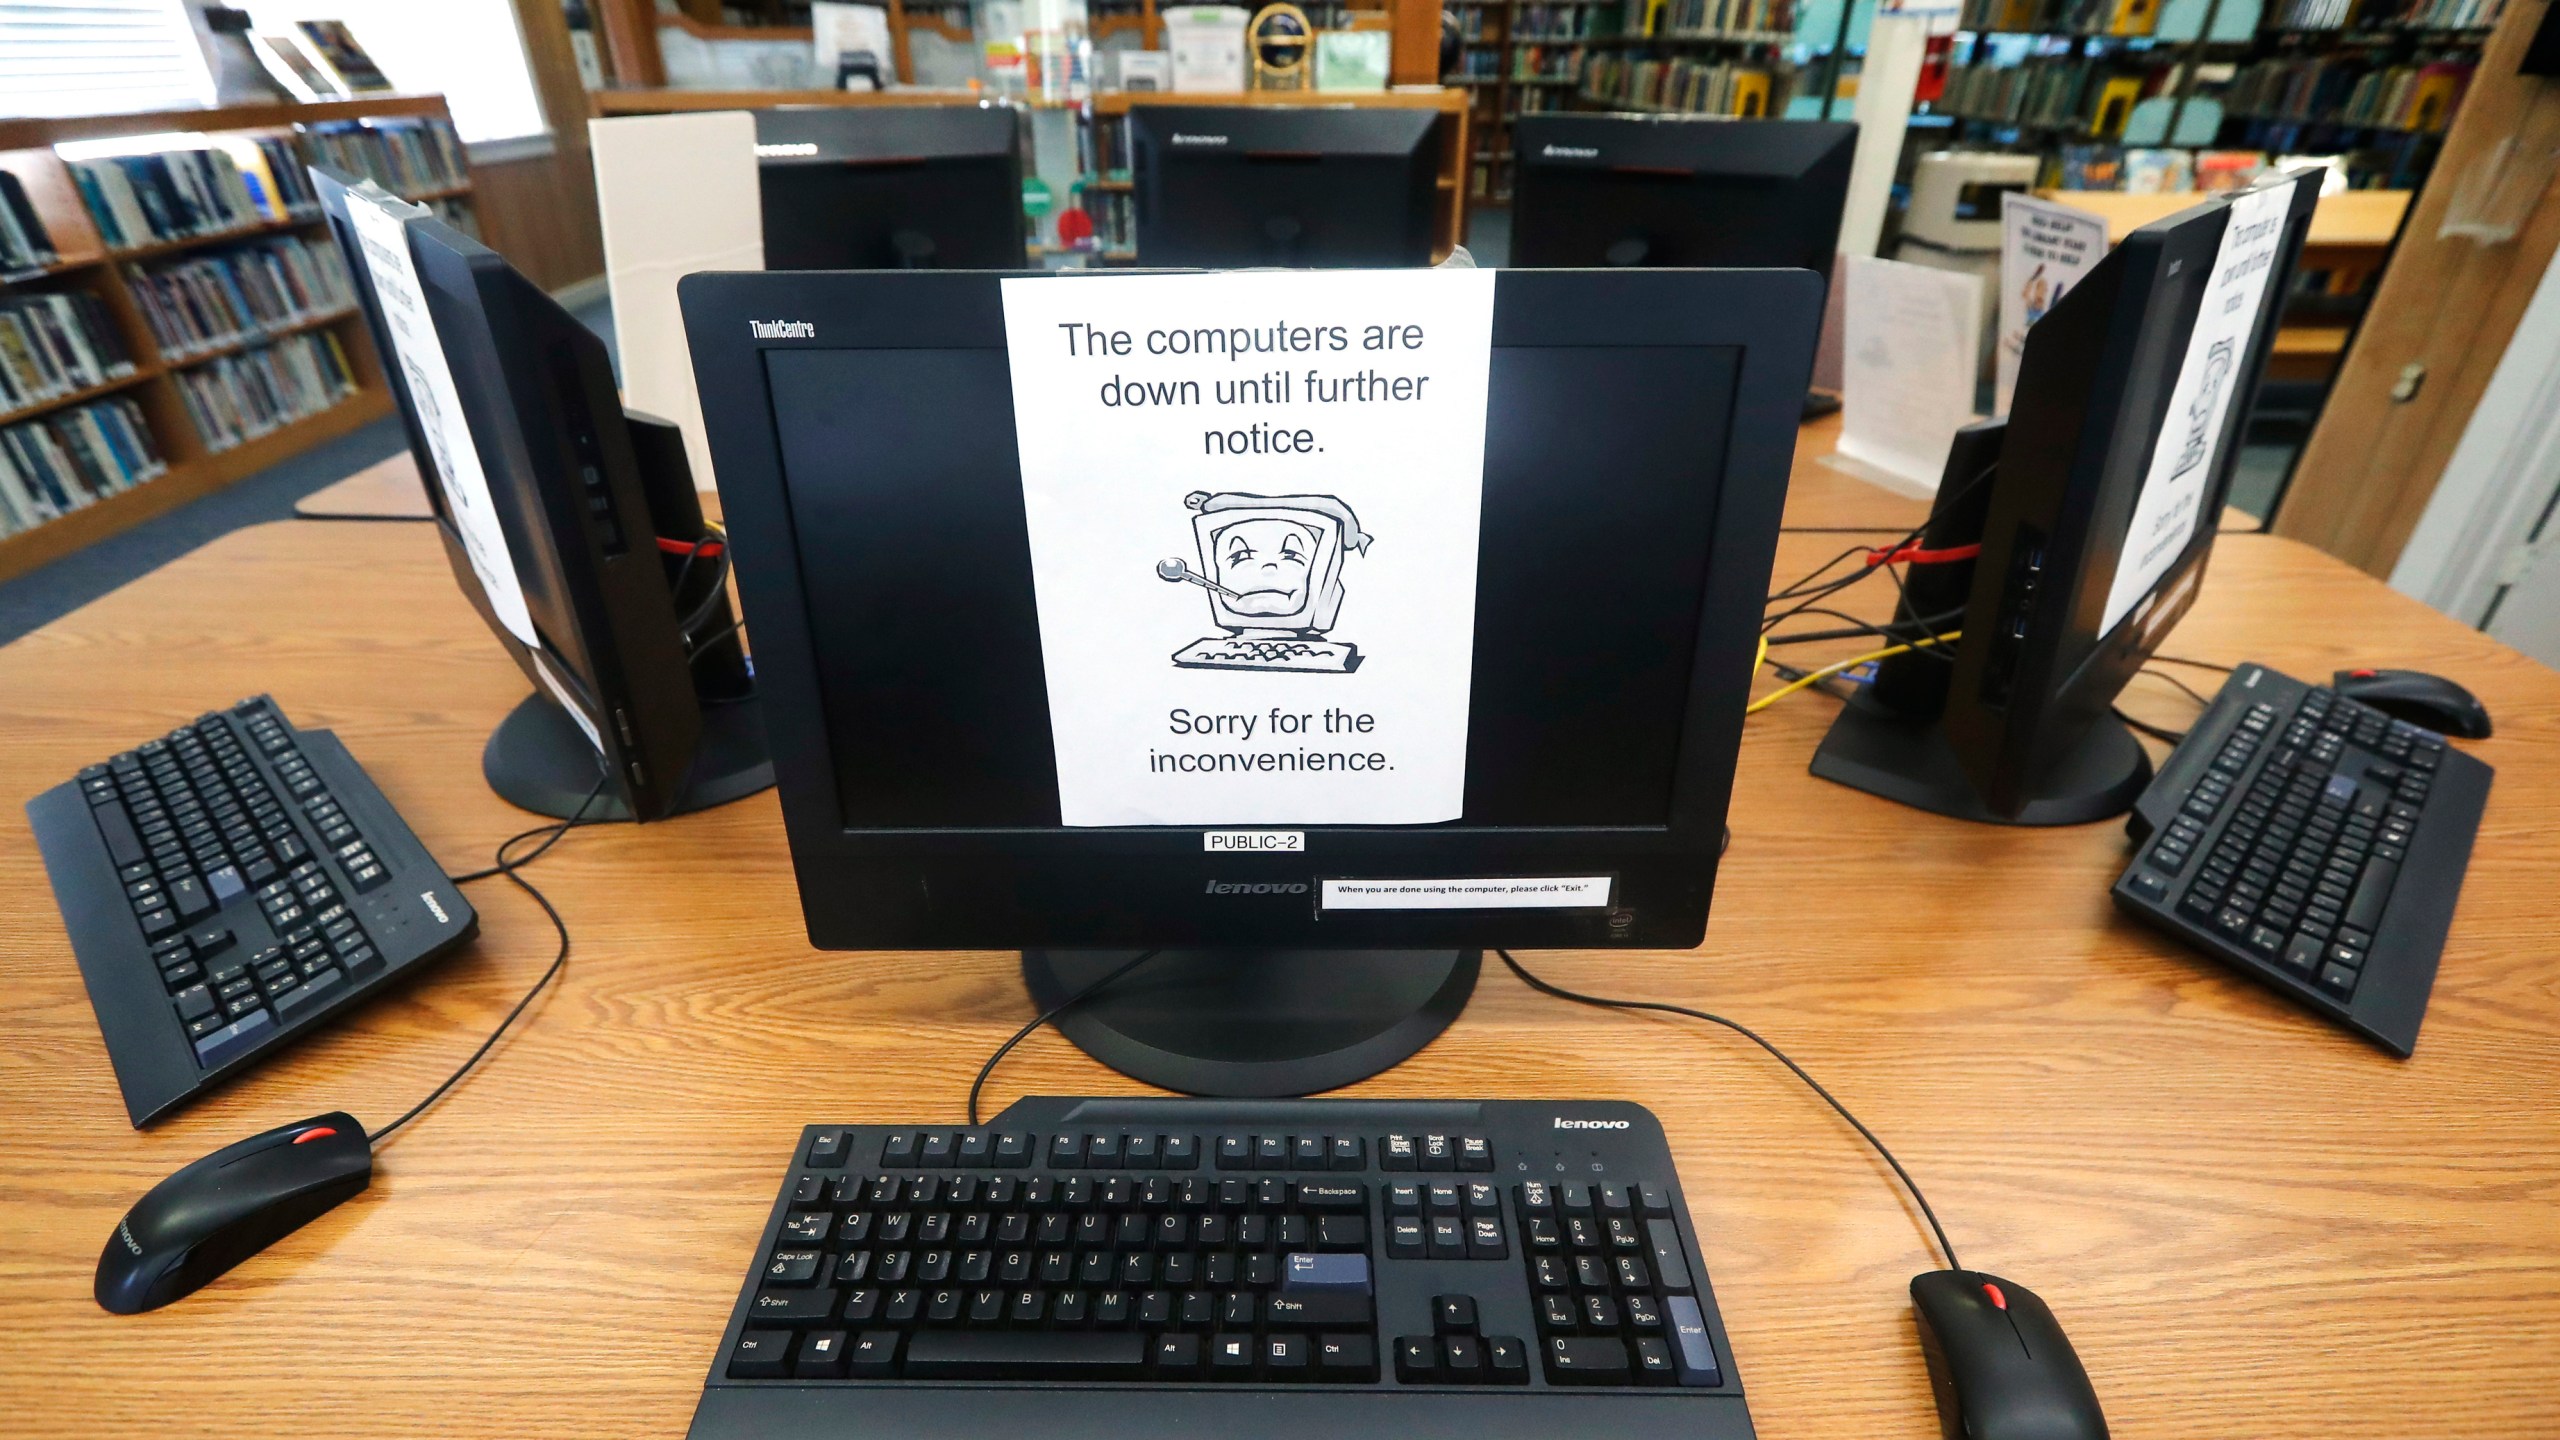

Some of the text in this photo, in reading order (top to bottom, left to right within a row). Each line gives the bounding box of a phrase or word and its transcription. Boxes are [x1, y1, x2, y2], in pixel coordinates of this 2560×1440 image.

[749, 320, 815, 338] ThinkCentre
[1059, 321, 1423, 361] The computers are
[1101, 370, 1429, 406] down until further
[1205, 422, 1323, 454] notice.
[1170, 708, 1374, 740] Sorry for the
[1151, 747, 1393, 772] inconvenience.
[1211, 836, 1297, 848] PUBLIC-2
[1205, 880, 1308, 894] lenovo
[1424, 886, 1446, 894] using
[1511, 885, 1538, 893] please
[1555, 1118, 1629, 1129] lenovo
[1473, 1184, 1489, 1193] Page
[848, 1215, 859, 1225] Q
[888, 1216, 901, 1225] W
[927, 1216, 936, 1226] E
[967, 1216, 976, 1225] R
[1007, 1217, 1015, 1226] T
[1047, 1217, 1055, 1227] Y
[1085, 1217, 1094, 1227] U
[1165, 1217, 1175, 1227] O
[1204, 1218, 1212, 1227] P
[1533, 1220, 1540, 1229] 7
[1574, 1221, 1581, 1230] 8
[1613, 1221, 1620, 1230] 9
[777, 1253, 795, 1261] Caps
[845, 1253, 854, 1263] A
[886, 1254, 895, 1264] S
[928, 1254, 937, 1263] D
[967, 1254, 976, 1263] F
[1009, 1255, 1018, 1264] G
[1050, 1255, 1059, 1265] H
[1090, 1256, 1097, 1265] J
[1130, 1256, 1139, 1266] K
[1171, 1256, 1178, 1266] L
[1541, 1260, 1549, 1269] 4
[1582, 1260, 1589, 1269] 5
[1622, 1260, 1630, 1269] 6
[853, 1292, 864, 1302] Z
[896, 1293, 906, 1302] X
[938, 1293, 948, 1303] C
[981, 1294, 990, 1303] V
[1022, 1294, 1031, 1303] B
[1064, 1294, 1074, 1304] N
[1105, 1295, 1117, 1305] M
[1549, 1298, 1554, 1308] 1
[1592, 1299, 1600, 1308] 2
[1632, 1299, 1640, 1308] 3
[1557, 1340, 1564, 1350] 0
